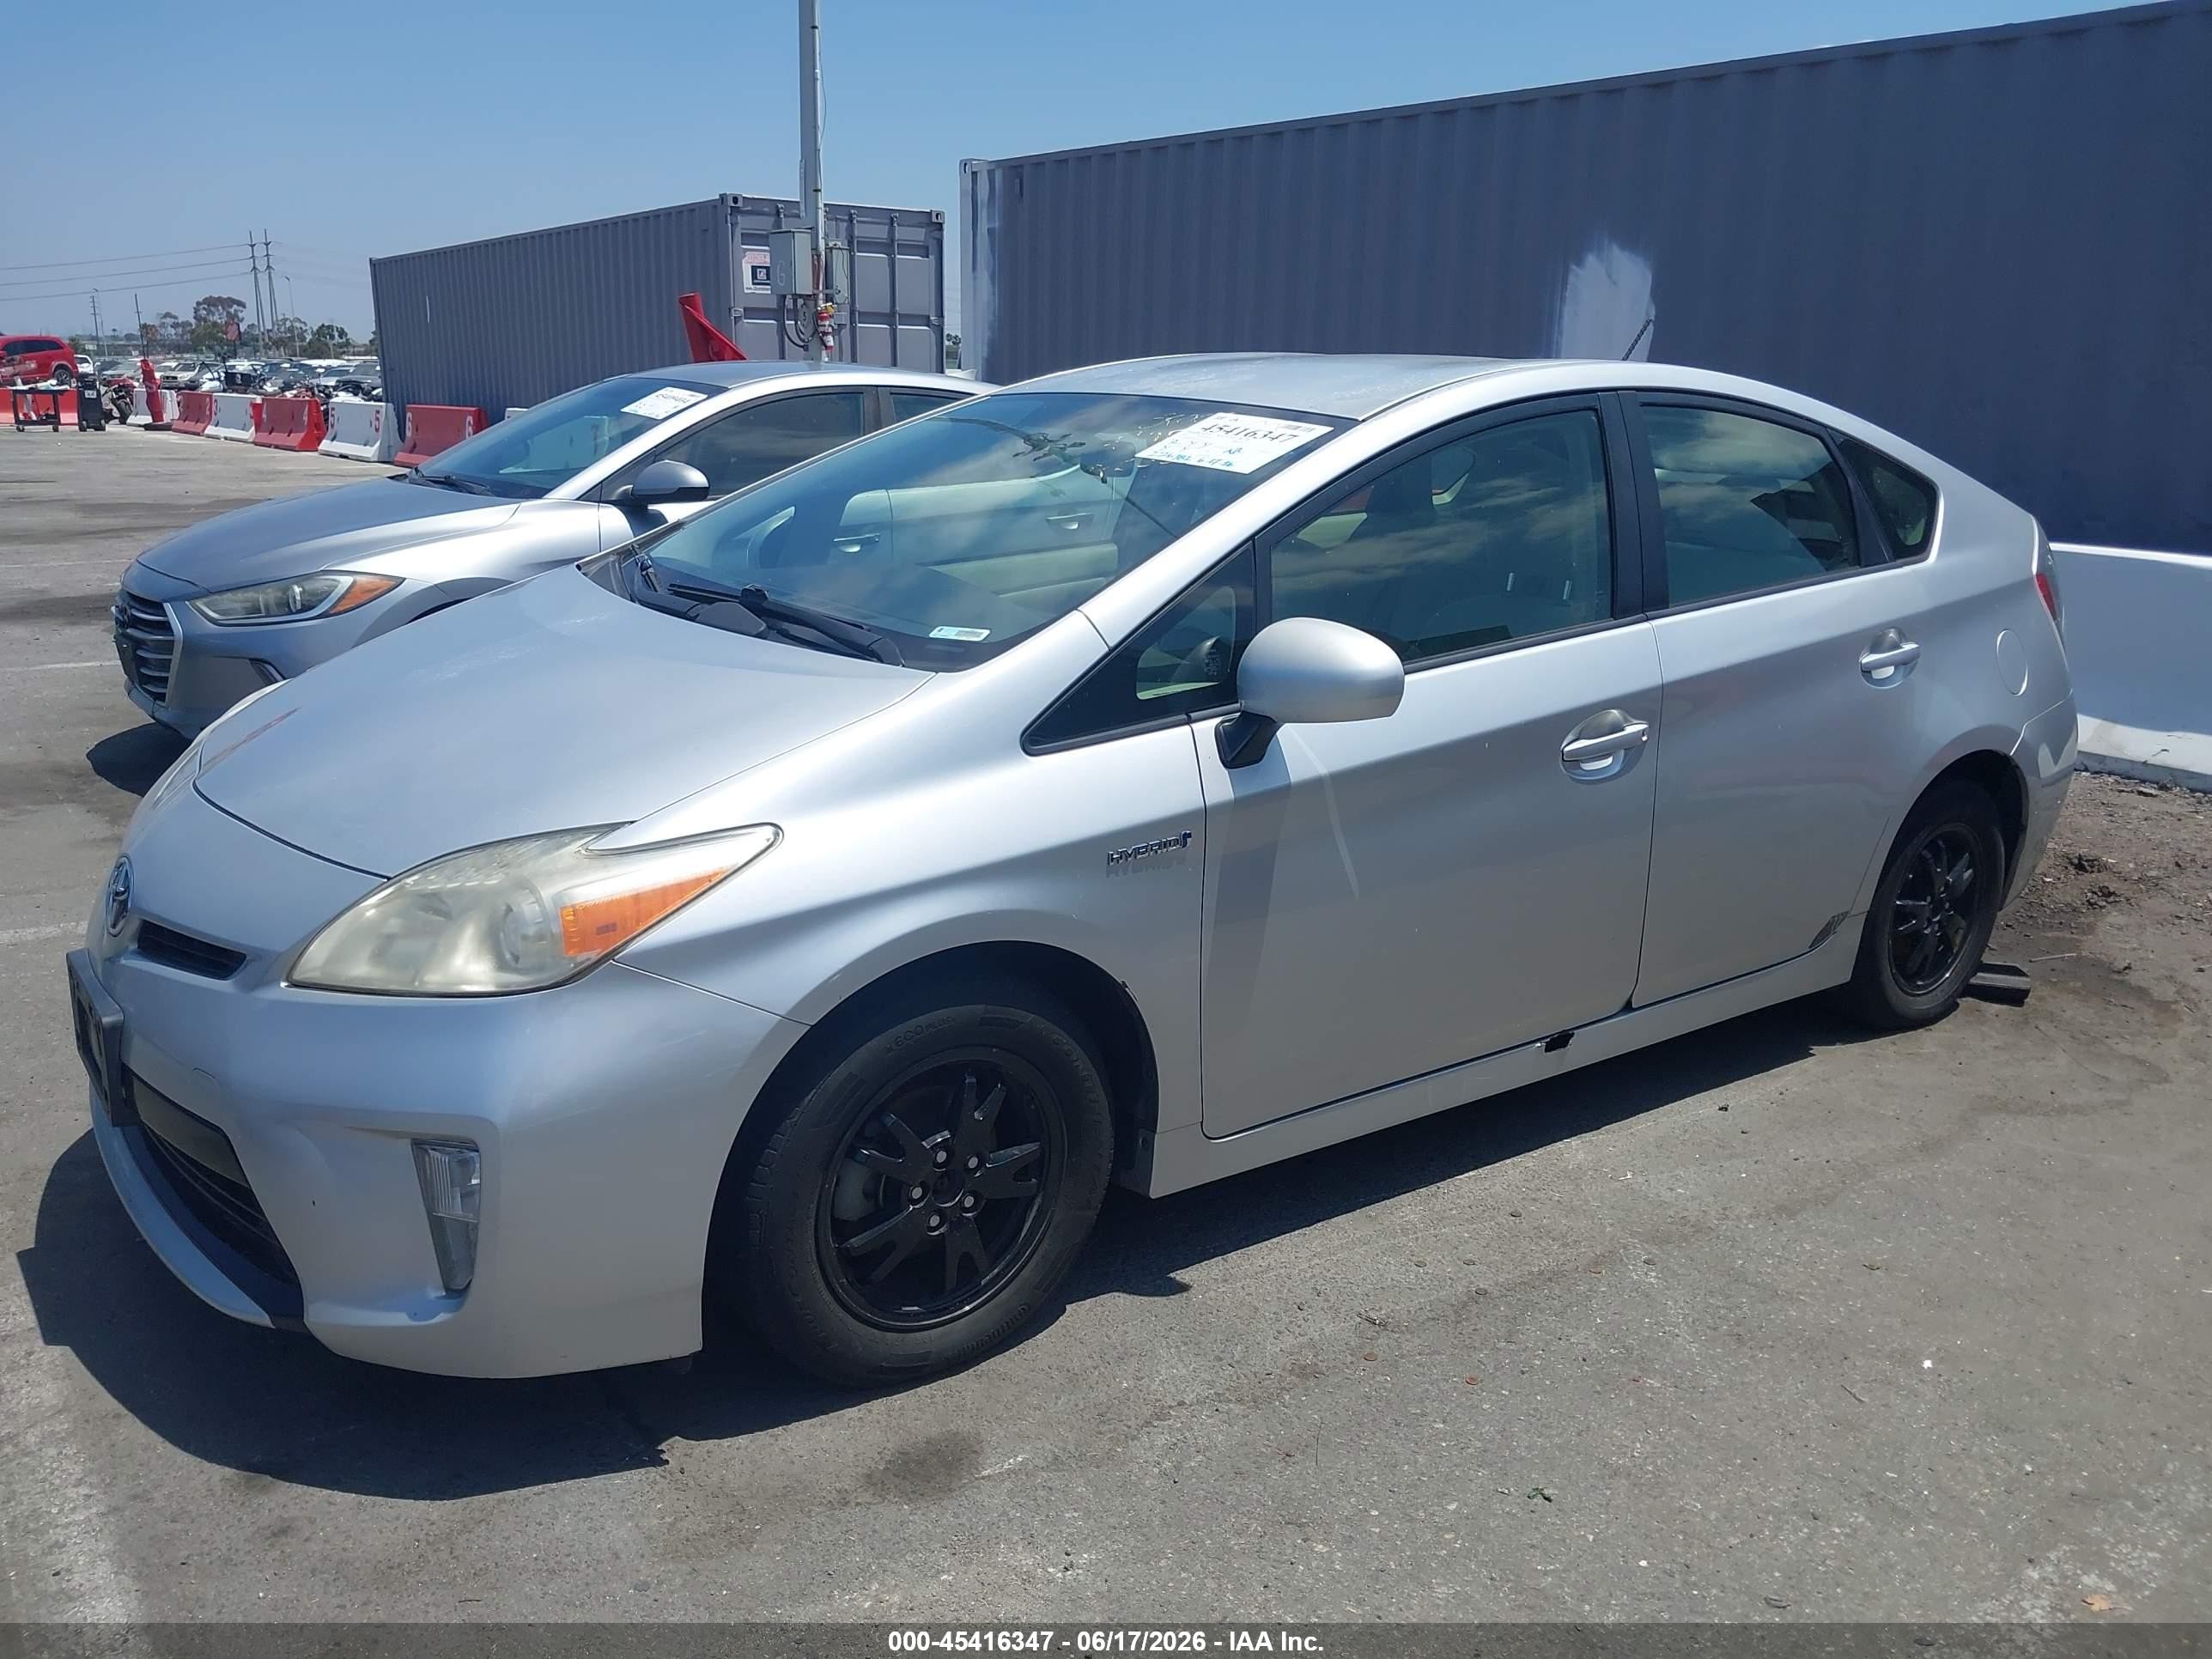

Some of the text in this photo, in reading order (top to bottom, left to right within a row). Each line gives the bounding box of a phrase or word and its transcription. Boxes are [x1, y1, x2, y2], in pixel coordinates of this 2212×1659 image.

[330, 407, 380, 433] 5 5
[406, 412, 473, 440] 6 6
[1201, 423, 1299, 443] 45416347
[1107, 836, 1180, 866] HYBRID
